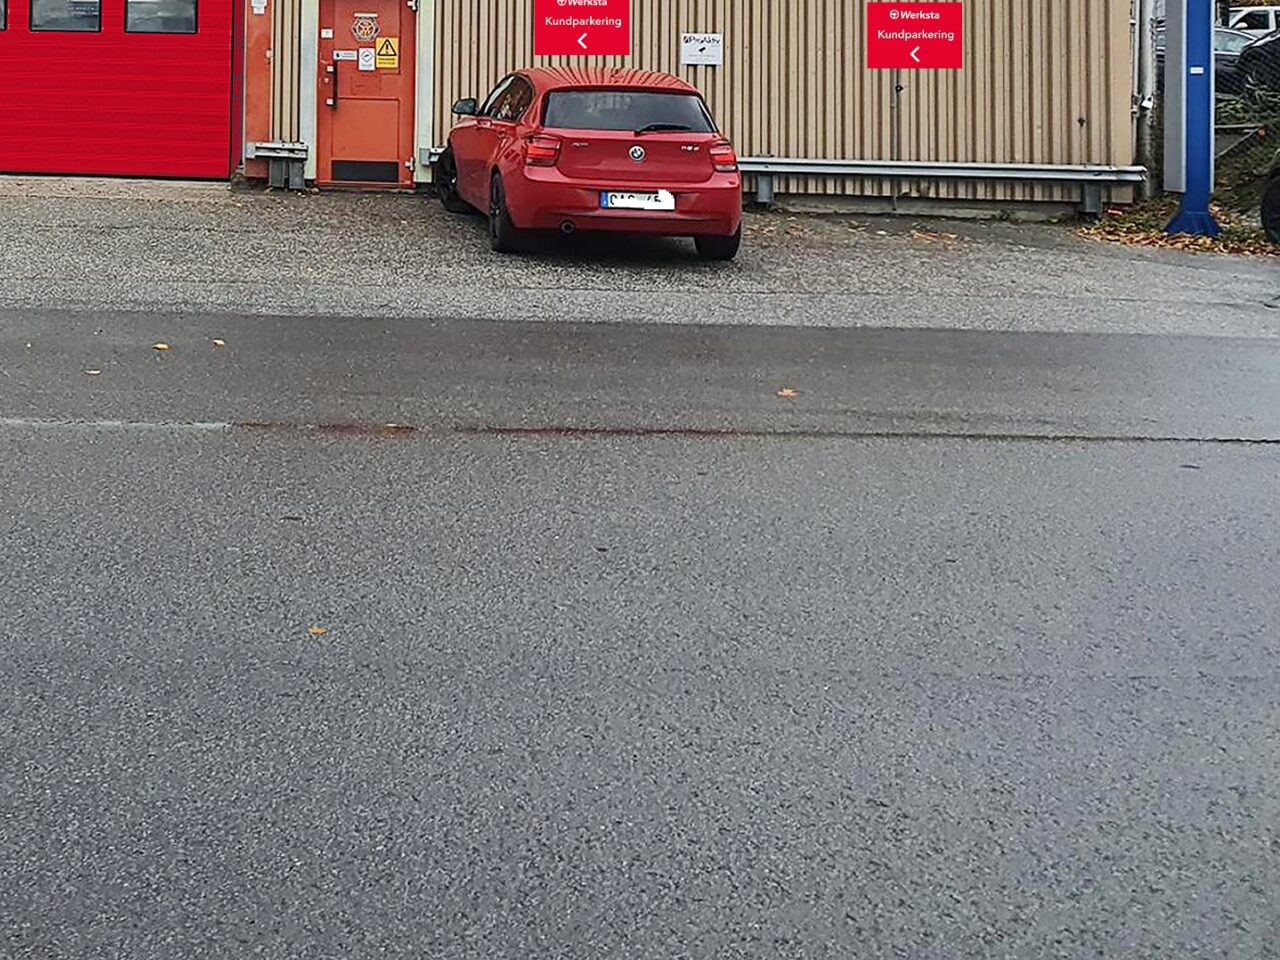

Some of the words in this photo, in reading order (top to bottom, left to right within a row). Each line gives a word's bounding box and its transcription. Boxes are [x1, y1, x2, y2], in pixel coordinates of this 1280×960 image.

[900, 10, 940, 20] Werksta
[545, 16, 622, 29] Kundparkering
[877, 29, 954, 42] Kundparkering
